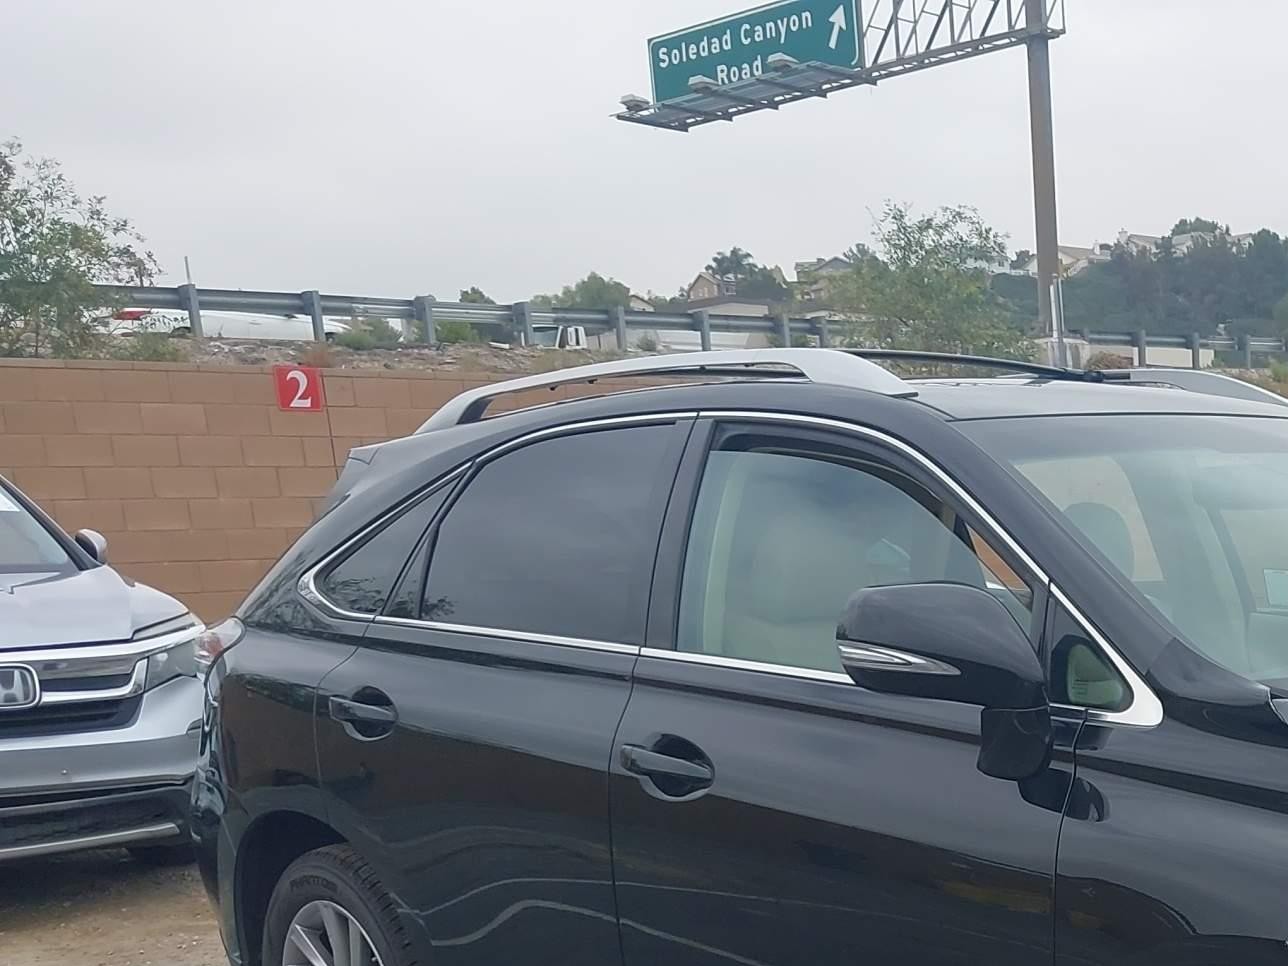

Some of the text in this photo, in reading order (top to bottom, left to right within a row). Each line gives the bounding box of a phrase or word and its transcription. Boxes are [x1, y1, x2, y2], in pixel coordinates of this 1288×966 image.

[658, 10, 812, 68] Soledad Canyon
[716, 55, 763, 86] Road
[286, 370, 312, 408] 2
